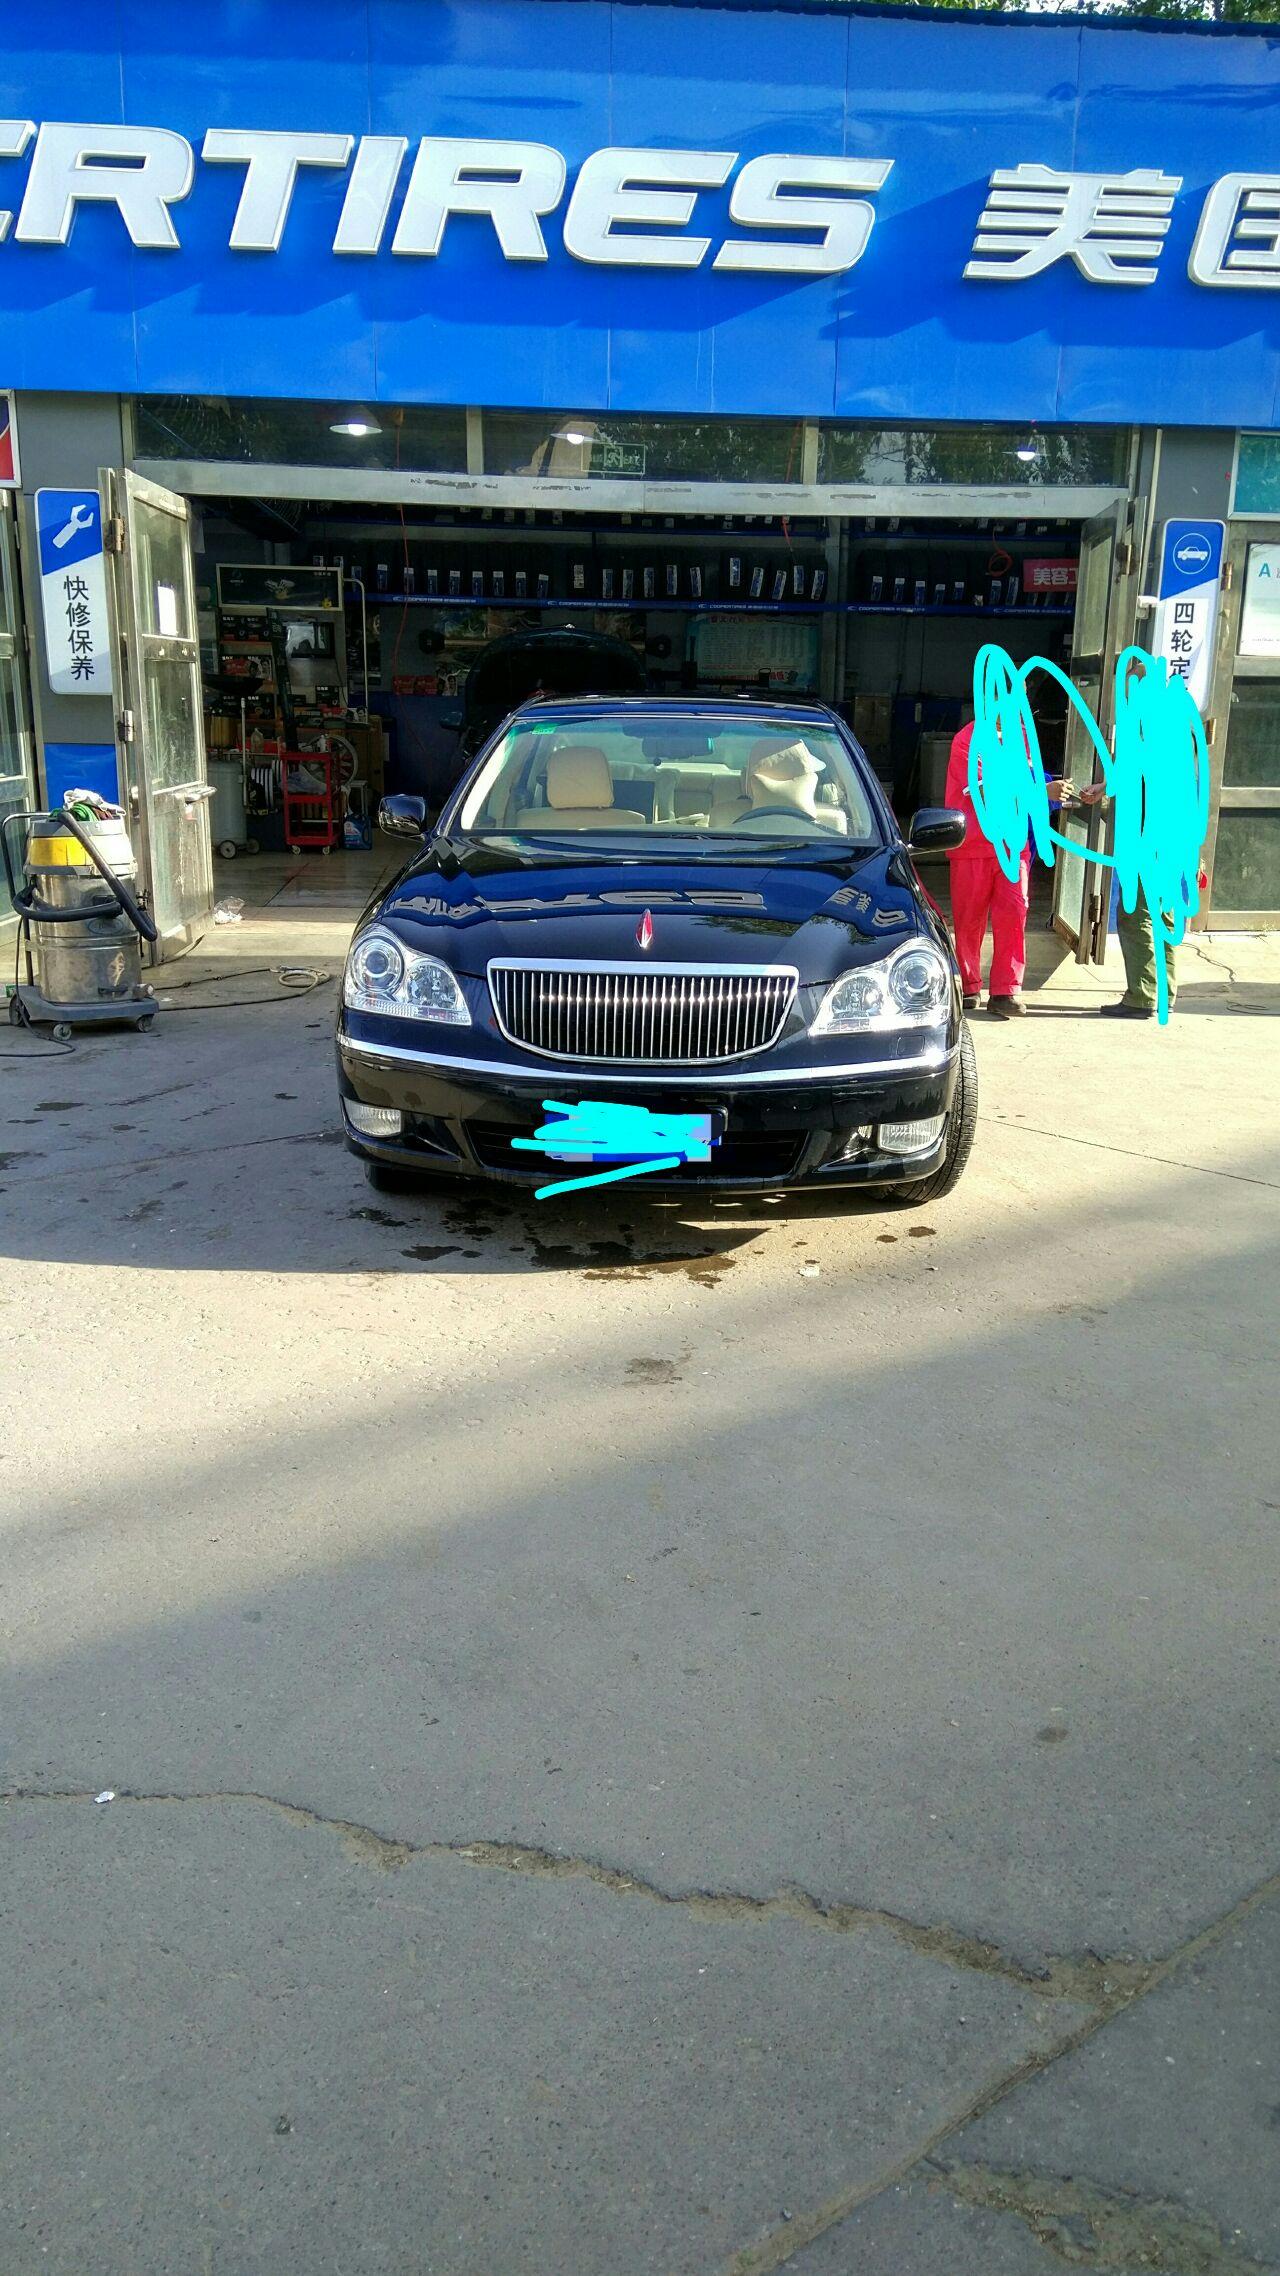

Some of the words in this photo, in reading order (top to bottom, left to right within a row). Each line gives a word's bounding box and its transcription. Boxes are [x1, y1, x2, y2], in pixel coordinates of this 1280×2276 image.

[0, 120, 895, 274] RTIRES
[64, 575, 95, 681] 快修保养
[1169, 603, 1195, 690] 四轮定
